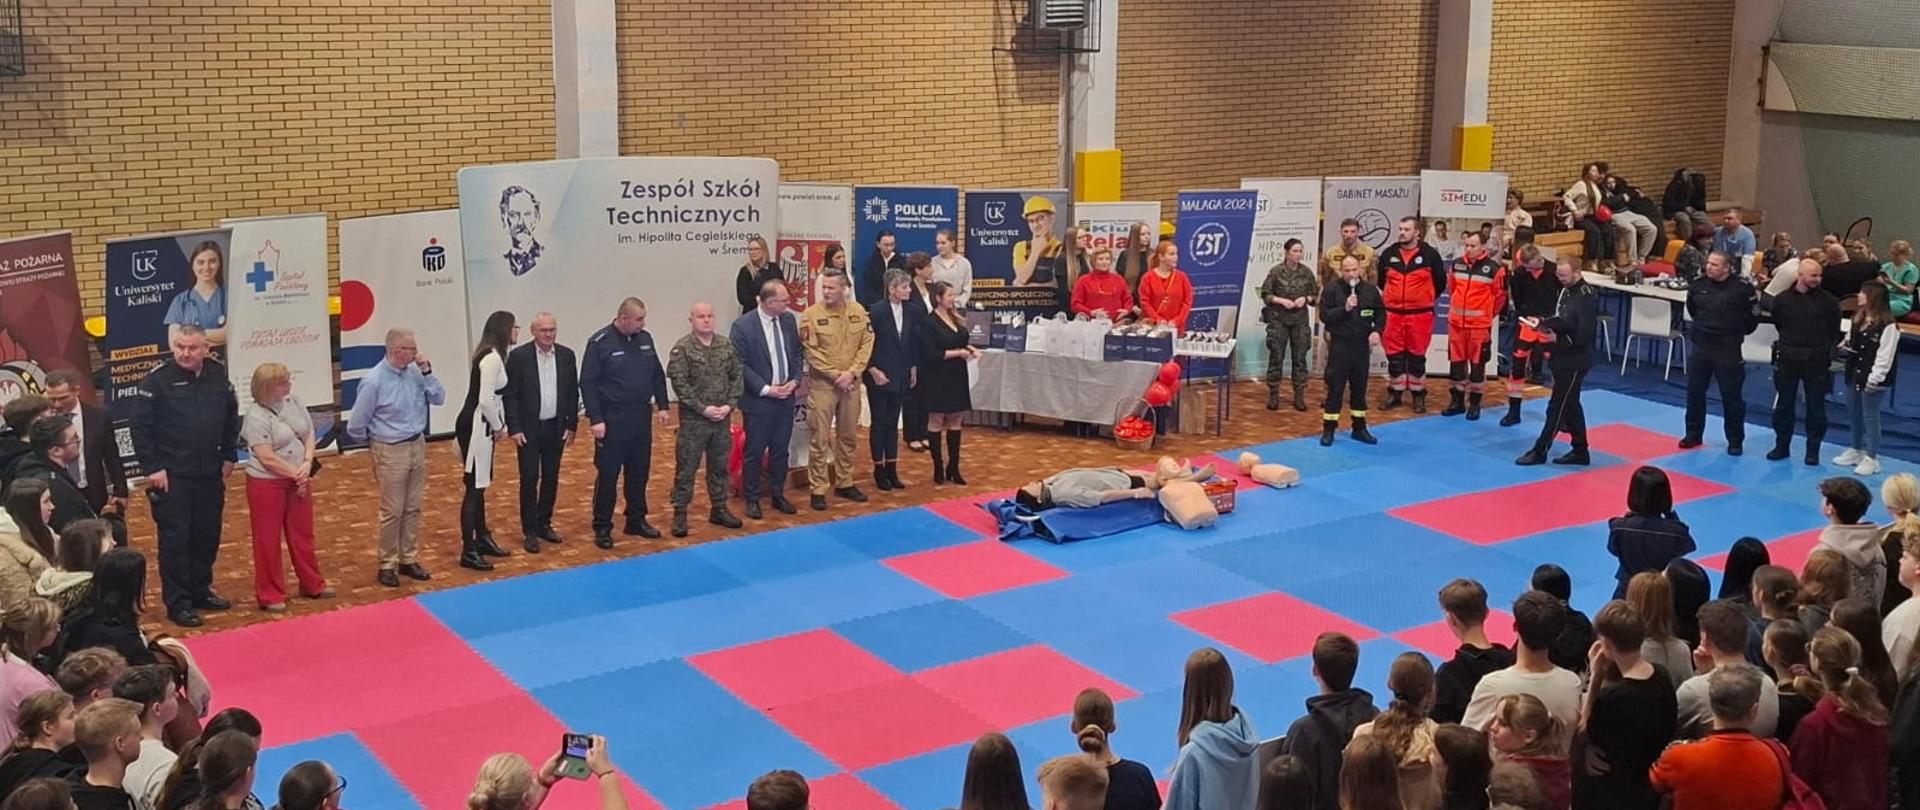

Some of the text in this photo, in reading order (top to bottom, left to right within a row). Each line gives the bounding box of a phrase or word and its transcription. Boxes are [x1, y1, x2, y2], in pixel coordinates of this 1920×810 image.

[620, 177, 761, 202] Zespół Szkół
[1337, 189, 1372, 199] GABINET
[1181, 198, 1253, 211] MALAGA 2024
[1441, 192, 1487, 203] SIMEDU
[894, 204, 944, 216] POLICJA
[988, 207, 1005, 218] UK
[1257, 200, 1268, 212] ST
[606, 205, 760, 226] Technicznych
[638, 231, 682, 244] Hipolita
[685, 230, 761, 243] Cegielskiego
[709, 244, 751, 255] w Śrem
[1196, 233, 1224, 256] ZST
[14, 252, 64, 269] POŻARNA
[136, 257, 157, 272] UK
[115, 281, 175, 297] Uniwersytet
[127, 291, 162, 306] Kaliski
